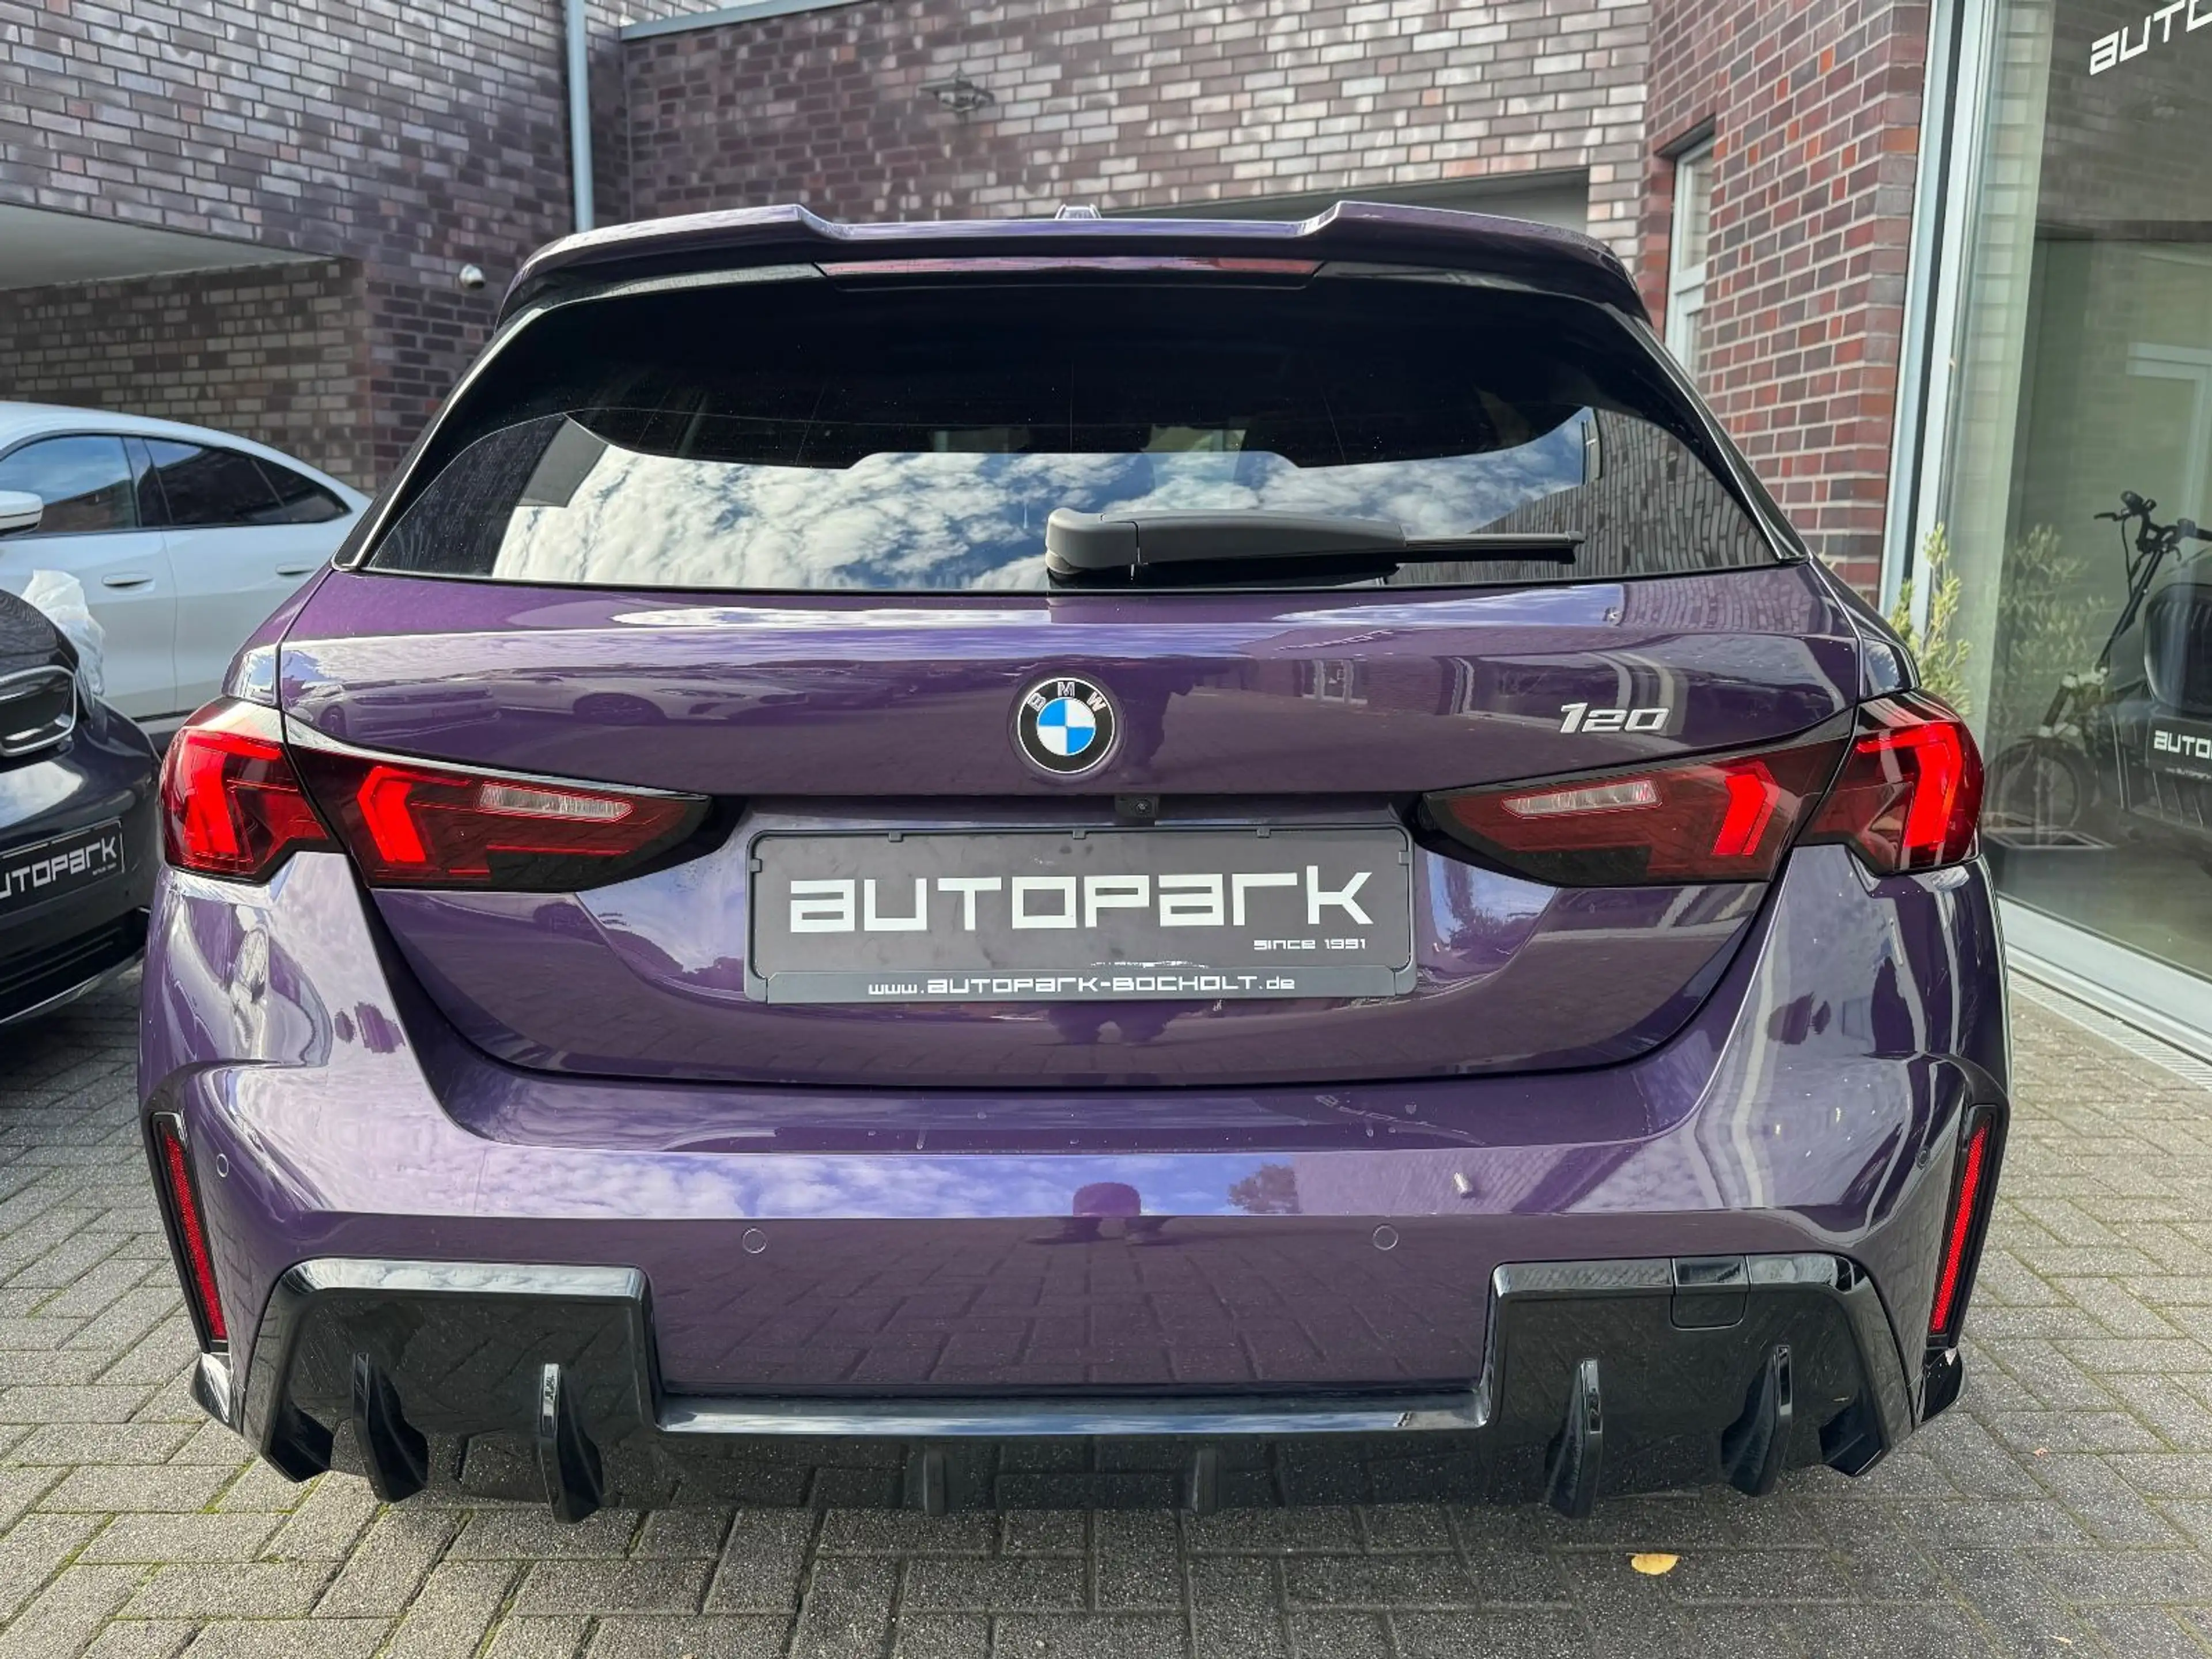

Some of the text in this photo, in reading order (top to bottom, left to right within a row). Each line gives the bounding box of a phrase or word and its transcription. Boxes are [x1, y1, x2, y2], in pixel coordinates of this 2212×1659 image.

[1027, 681, 1107, 712] BMW
[1560, 702, 1669, 733] 120
[1253, 938, 1365, 950] since 1991
